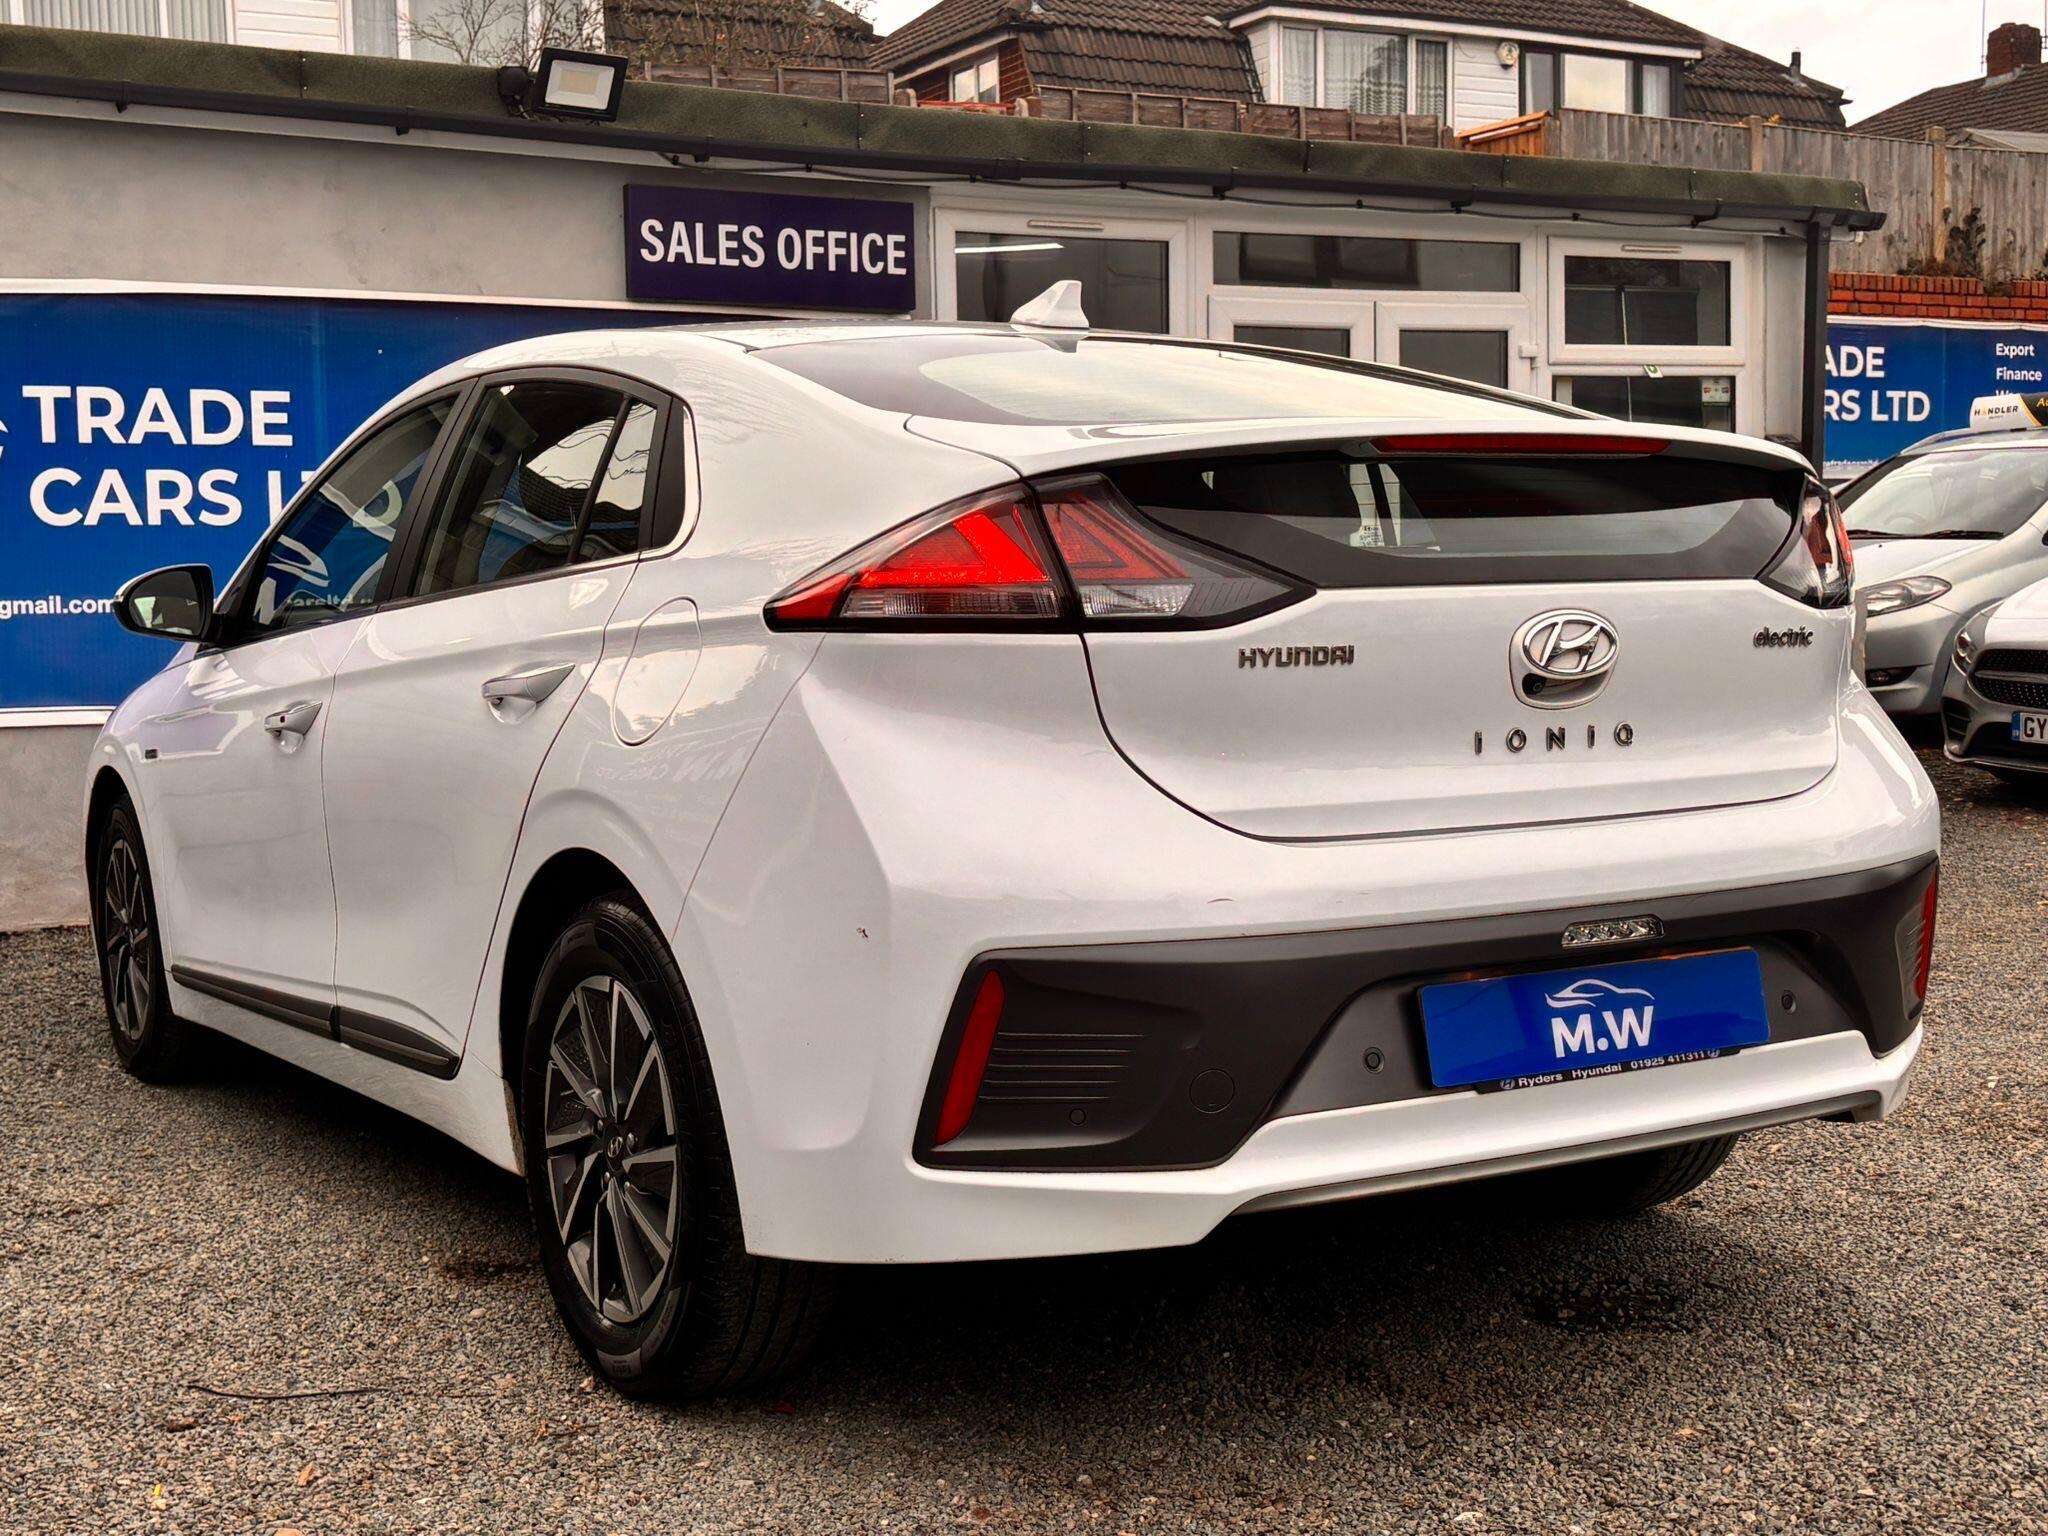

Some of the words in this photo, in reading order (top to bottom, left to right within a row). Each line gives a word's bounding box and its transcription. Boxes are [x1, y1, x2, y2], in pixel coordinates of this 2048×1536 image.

[640, 218, 766, 268] SALES
[777, 227, 907, 276] OFFICE
[1995, 342, 2036, 359] Export
[1995, 366, 2043, 381] Finance
[22, 385, 293, 447] TRADE
[1871, 389, 1931, 422] LTD
[29, 468, 243, 527] CARS
[1754, 625, 1814, 649] electric
[1238, 644, 1355, 669] HYUNDAI
[1473, 720, 1635, 756] IONIQ
[2023, 716, 2048, 740] GY
[1550, 1004, 1654, 1059] M.W
[1517, 1072, 1564, 1089] Ryders
[1571, 1063, 1623, 1080] Hyundai
[1630, 1056, 1665, 1070] 01925
[1667, 1050, 1706, 1064] 411311
